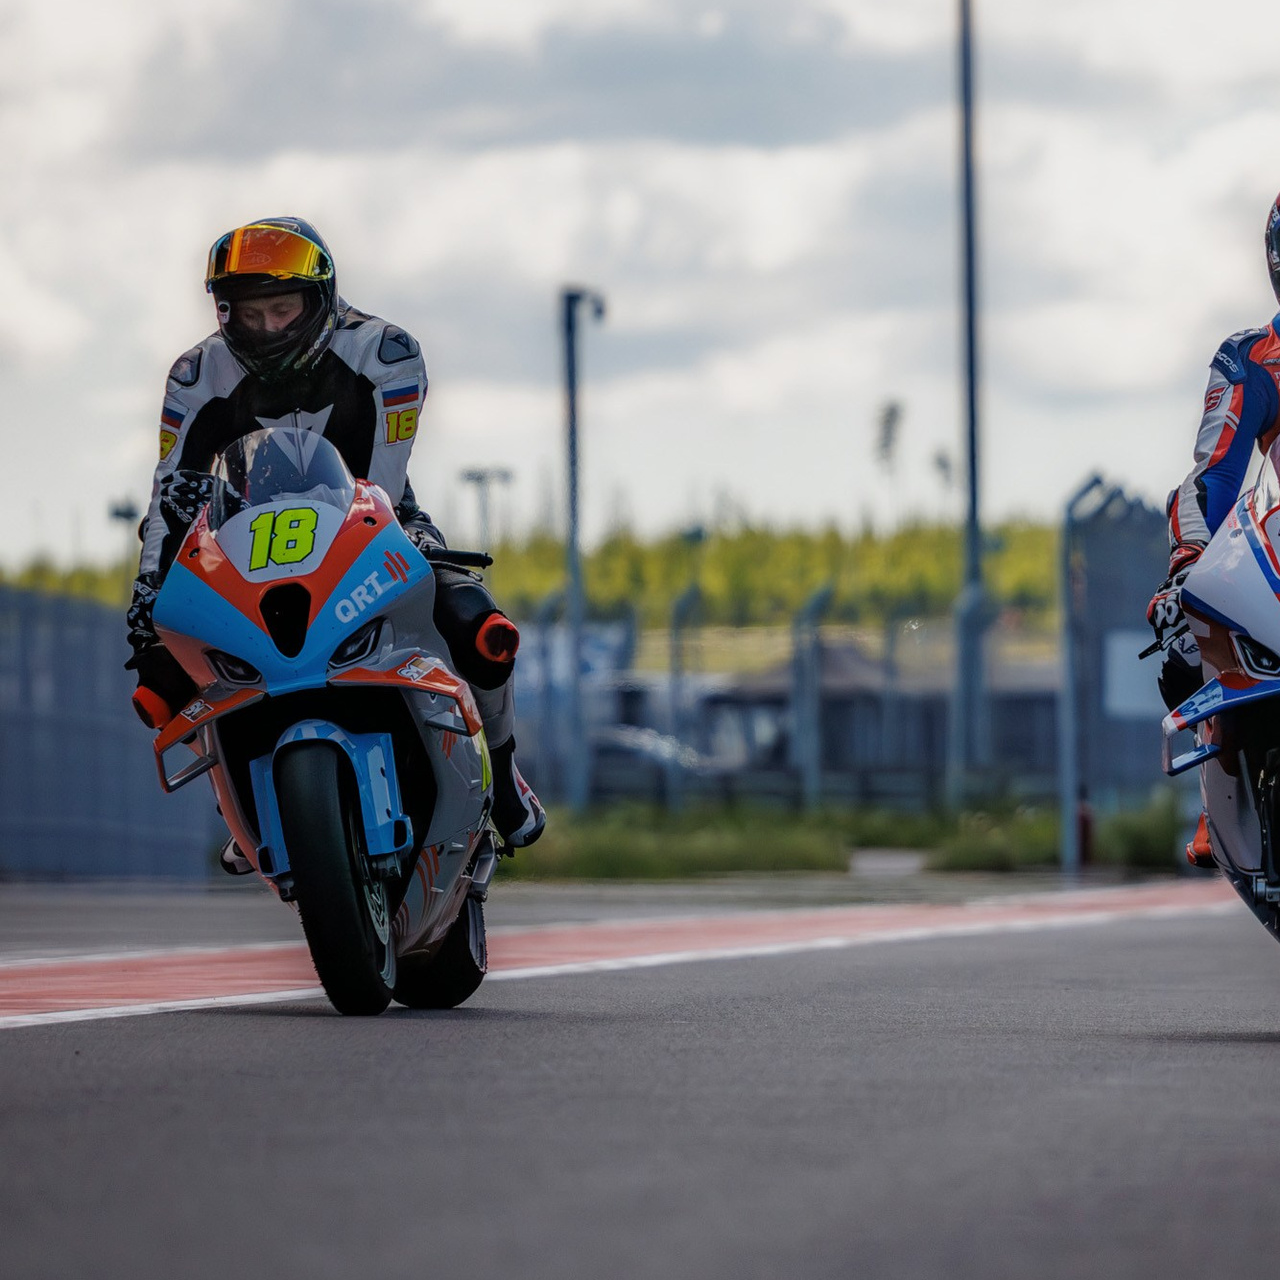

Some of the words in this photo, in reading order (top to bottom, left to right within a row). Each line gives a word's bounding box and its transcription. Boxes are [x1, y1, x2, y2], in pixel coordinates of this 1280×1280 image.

[385, 407, 418, 444] 18
[249, 507, 319, 572] 18
[335, 570, 383, 624] QRT
